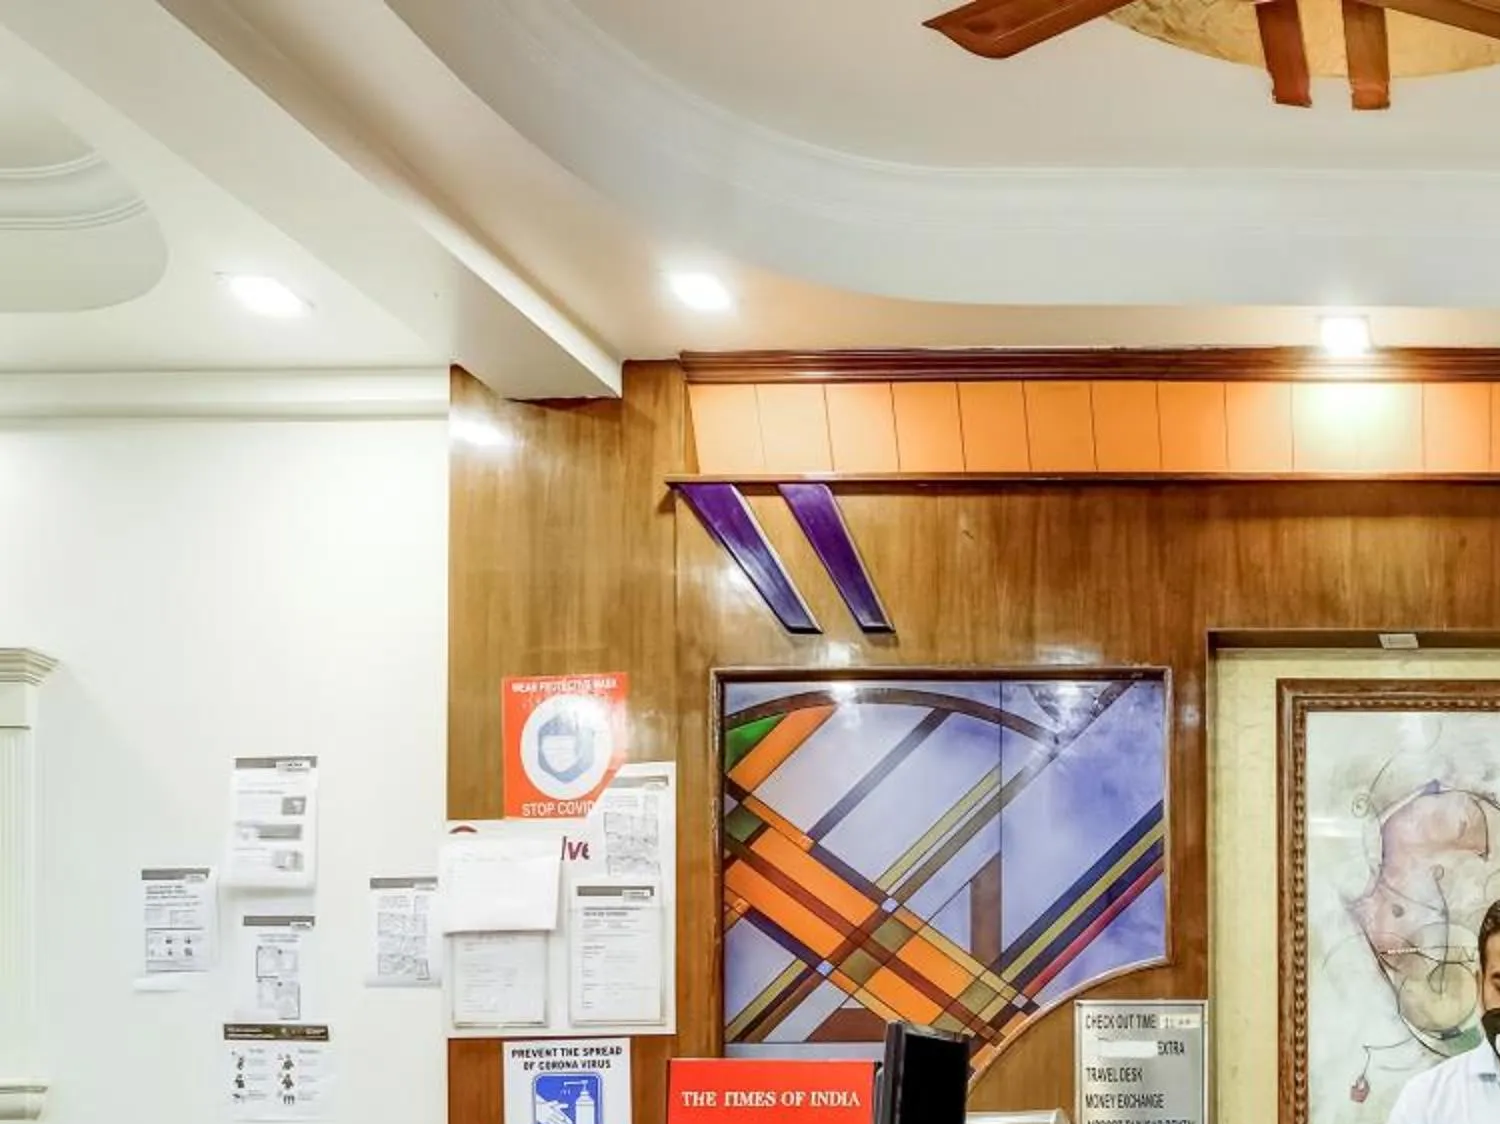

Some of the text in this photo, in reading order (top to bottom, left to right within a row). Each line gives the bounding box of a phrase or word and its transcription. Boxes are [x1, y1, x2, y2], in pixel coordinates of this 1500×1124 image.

[521, 802, 555, 817] STOP
[1086, 1014, 1115, 1029] CHECK
[1117, 1014, 1134, 1029] OUT
[1136, 1014, 1157, 1029] TIME
[512, 1046, 622, 1058] PREVENT THE SPREAD
[1157, 1041, 1185, 1055] EXTRA
[524, 1061, 612, 1071] OF CORONA VIRUS
[1085, 1067, 1143, 1082] TRAVEL DESK
[681, 1091, 861, 1107] THE TIMES OF INDIA
[1085, 1094, 1164, 1109] MONEY EXCHANGE
